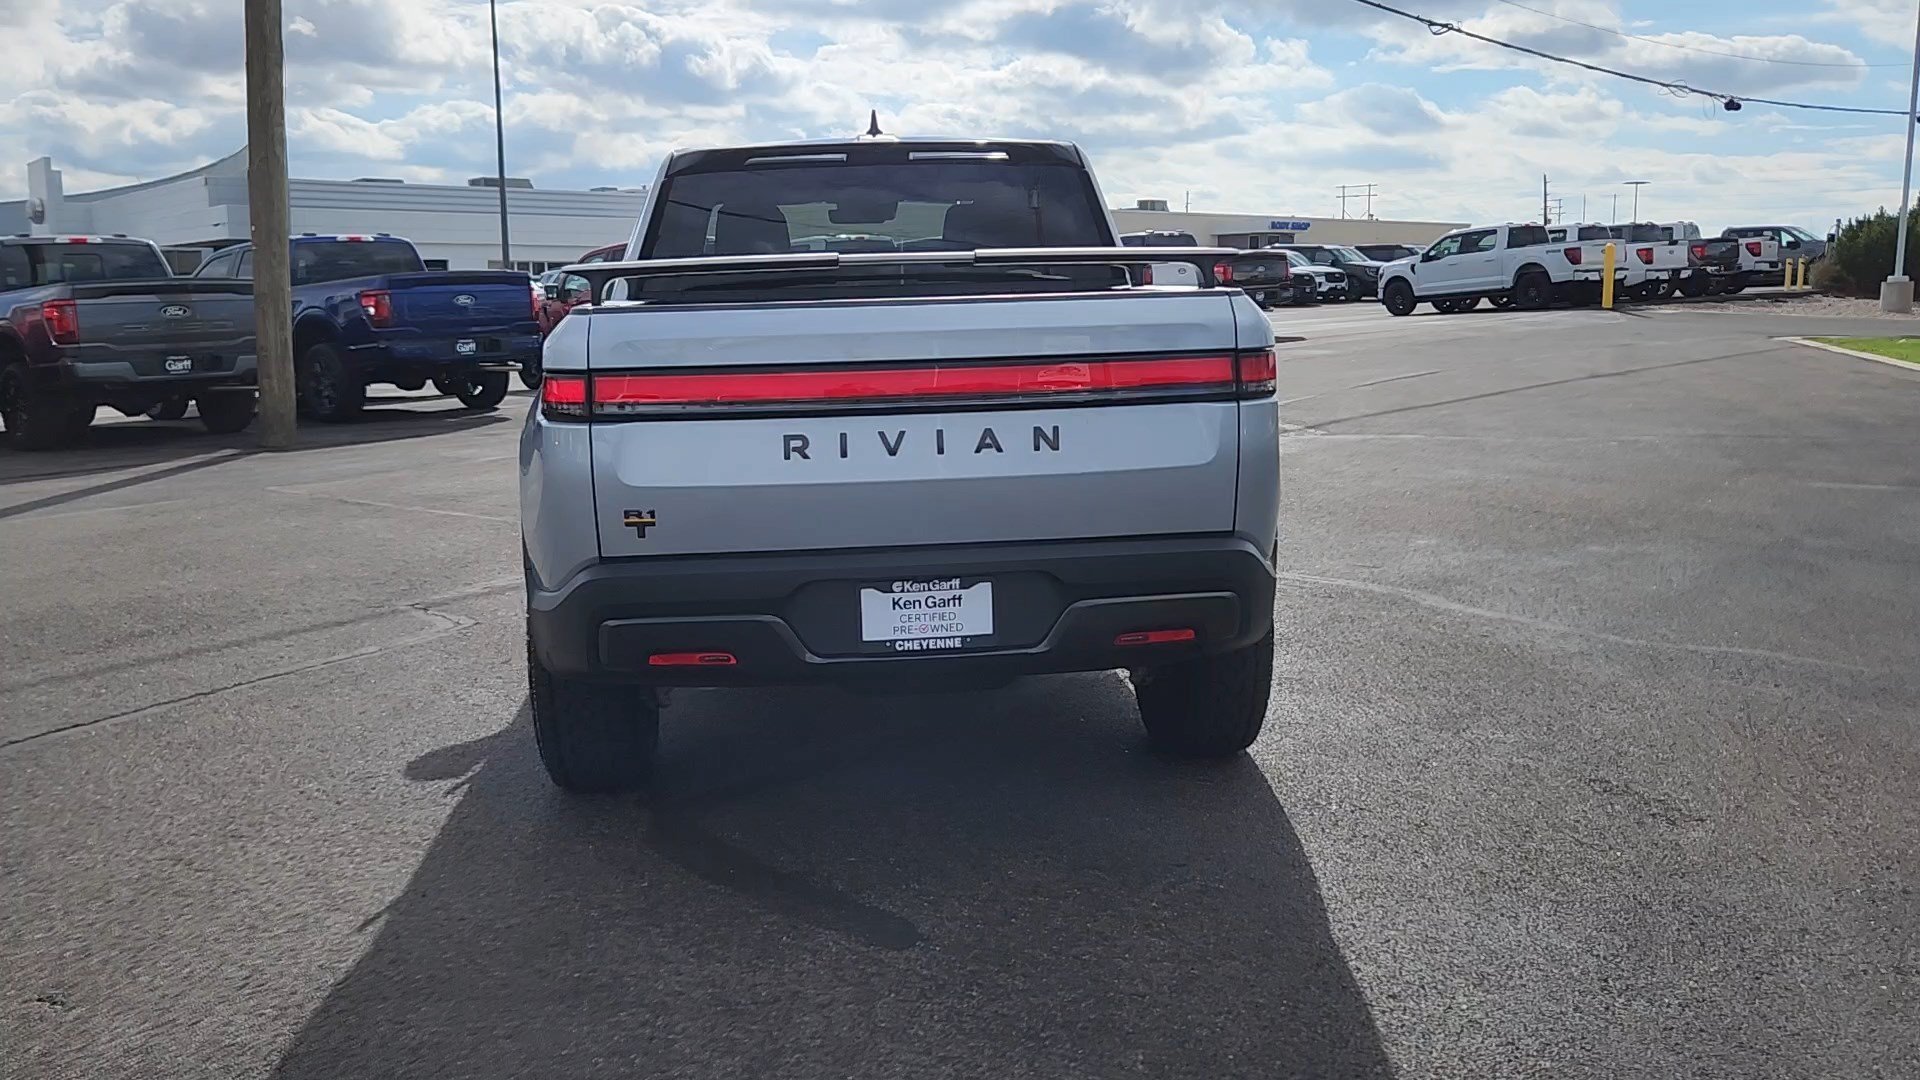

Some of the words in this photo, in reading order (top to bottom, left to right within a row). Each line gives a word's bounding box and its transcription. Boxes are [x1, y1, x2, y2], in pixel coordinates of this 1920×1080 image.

[165, 360, 192, 371] Garff
[783, 425, 1060, 460] RIVIAN
[904, 580, 929, 592] Ken
[929, 578, 961, 591] Garff
[892, 597, 921, 611] Ken
[925, 594, 963, 609] Garff
[899, 612, 957, 623] CERTIFIED
[895, 637, 962, 651] CHEYENNE
